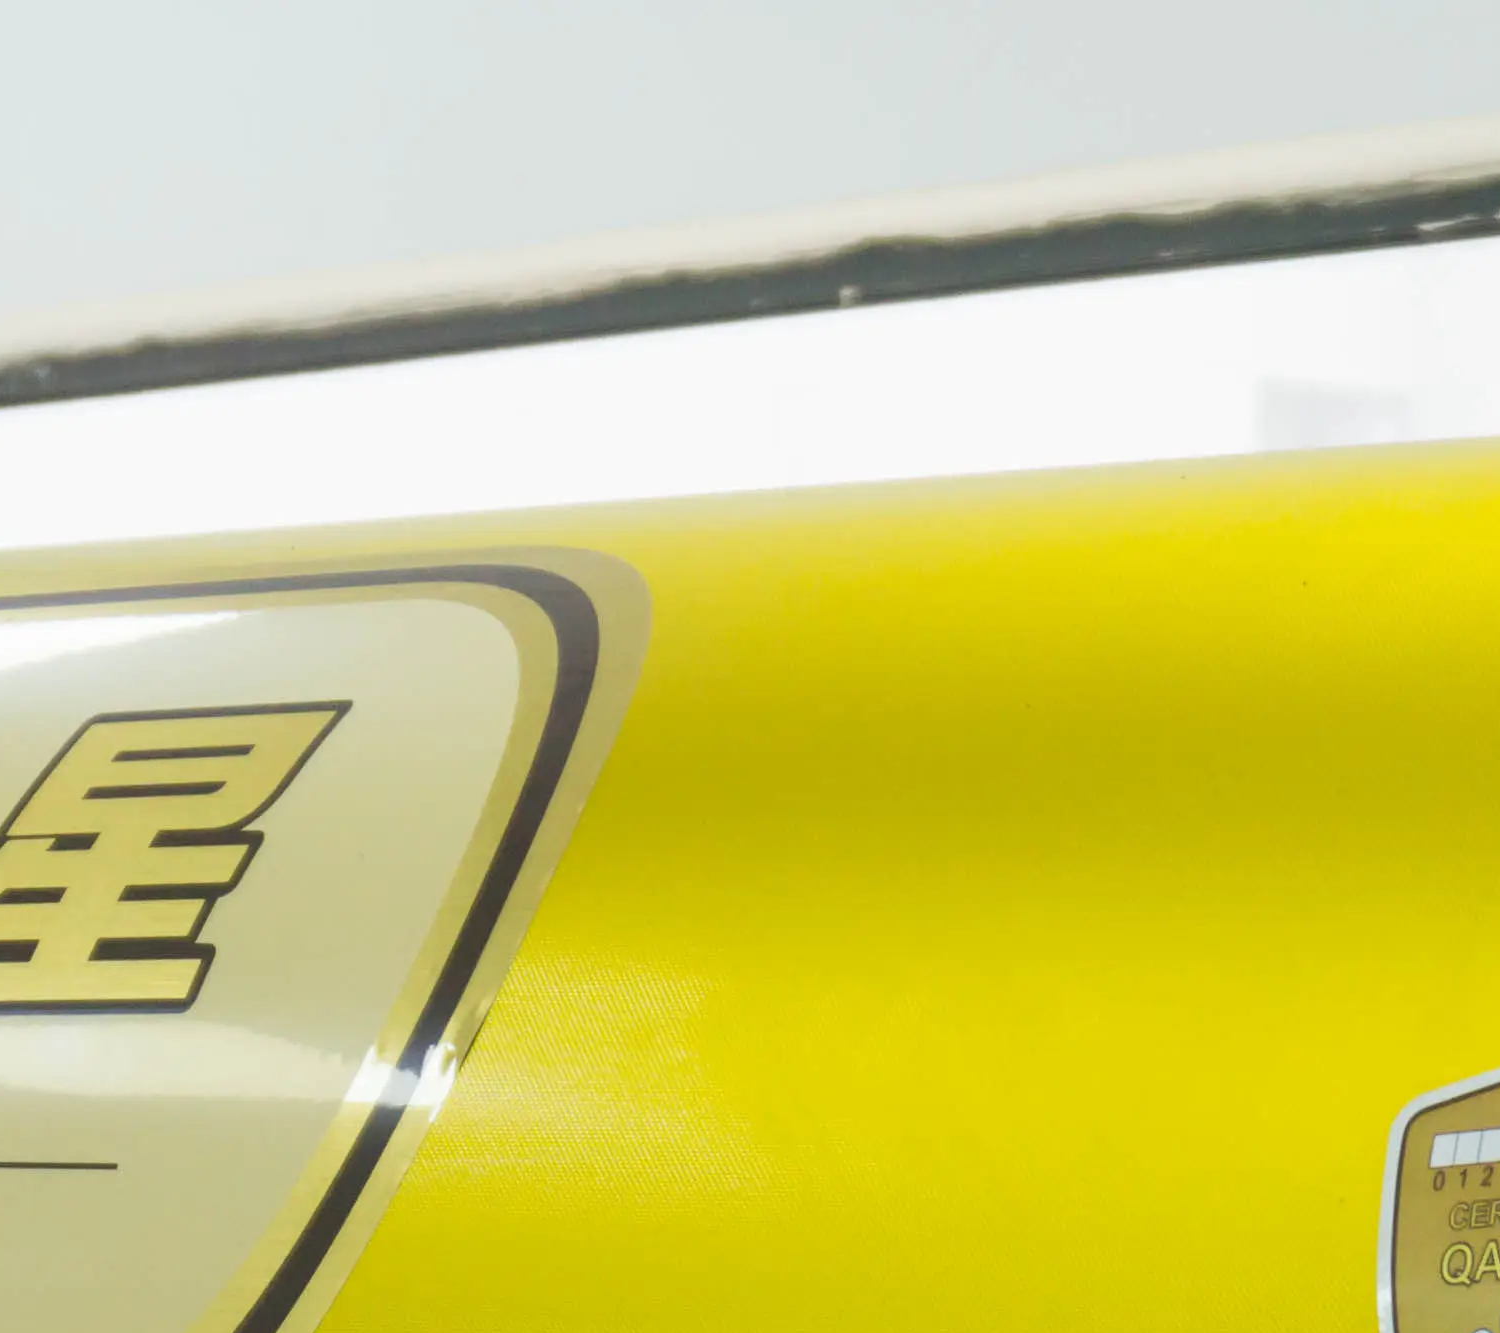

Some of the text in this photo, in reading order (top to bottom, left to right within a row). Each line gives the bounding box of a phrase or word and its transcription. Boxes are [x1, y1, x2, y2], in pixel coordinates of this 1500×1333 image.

[1433, 1170, 1445, 1191] 0
[1460, 1169, 1468, 1189] 1
[1479, 1166, 1494, 1187] 2
